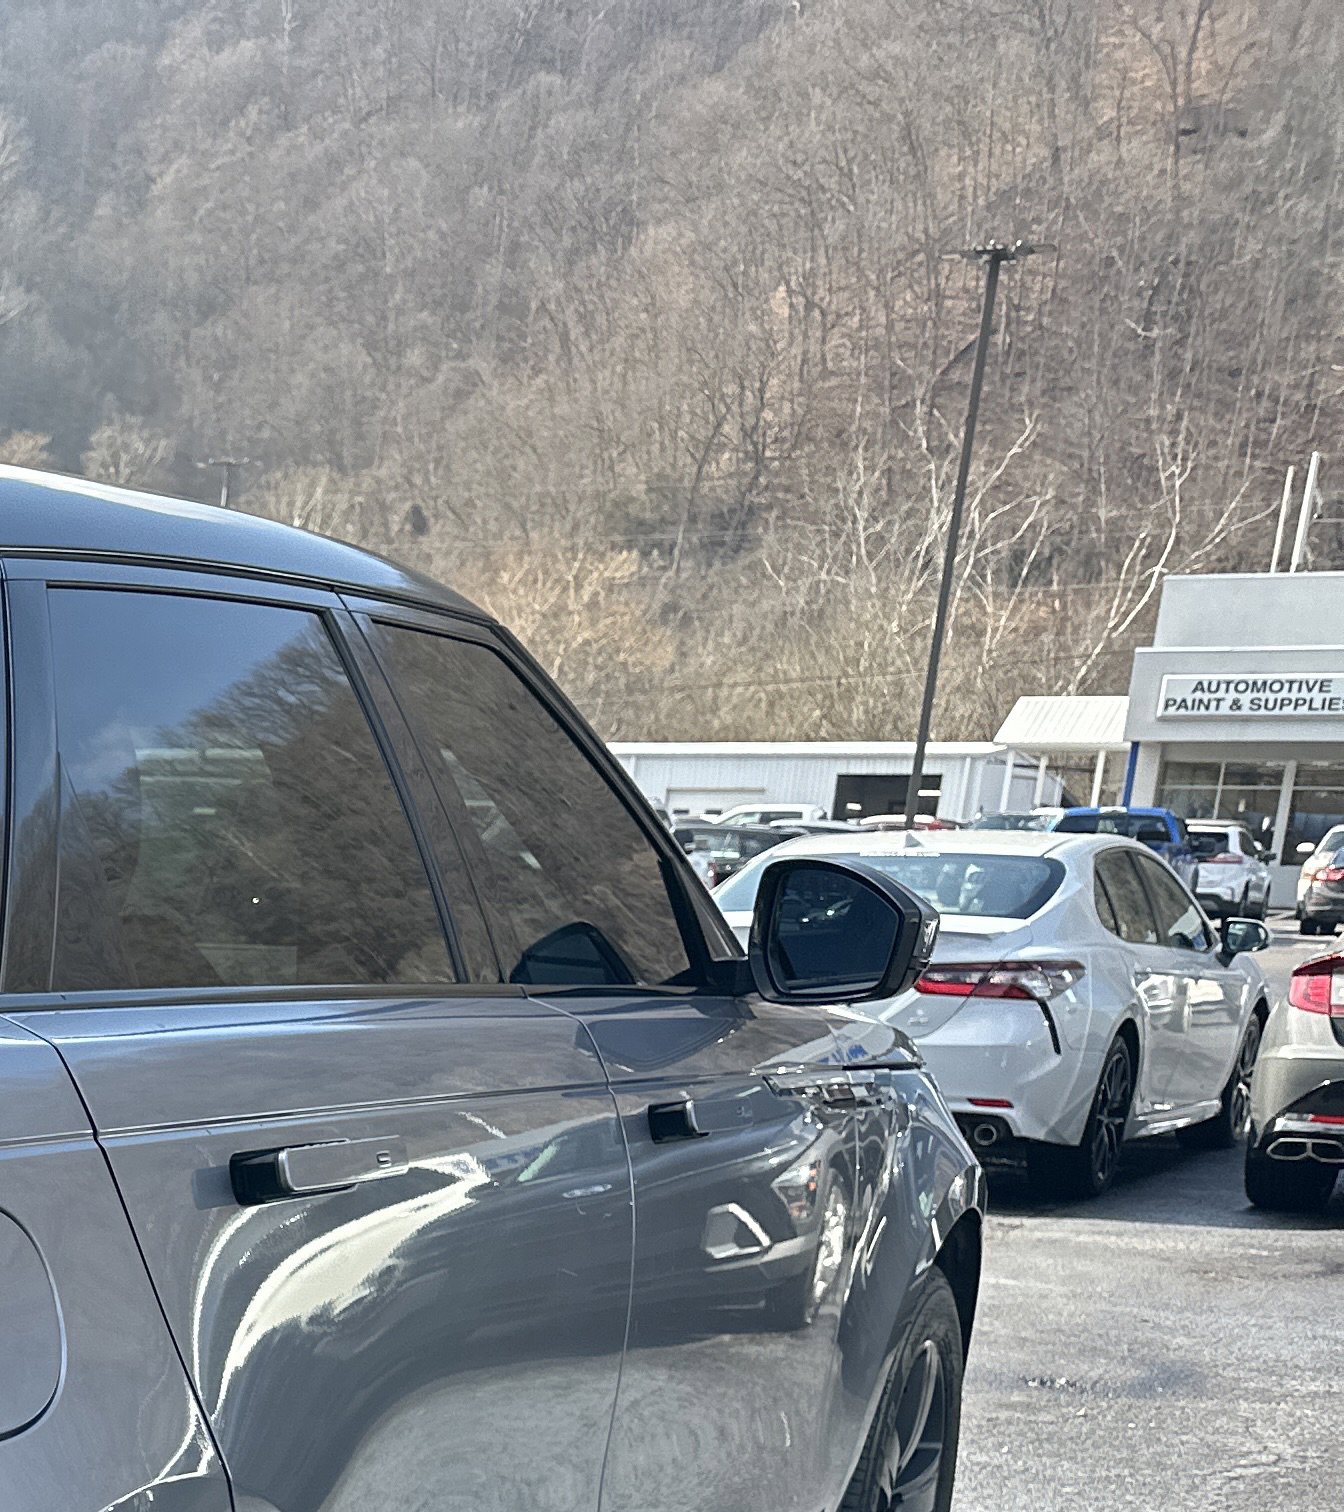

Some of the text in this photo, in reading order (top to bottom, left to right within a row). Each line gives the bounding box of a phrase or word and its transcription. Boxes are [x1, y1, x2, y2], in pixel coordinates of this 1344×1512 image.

[1191, 679, 1333, 694] AUTOMOTIVE
[1163, 697, 1224, 712] PAINT
[1229, 697, 1243, 712] &
